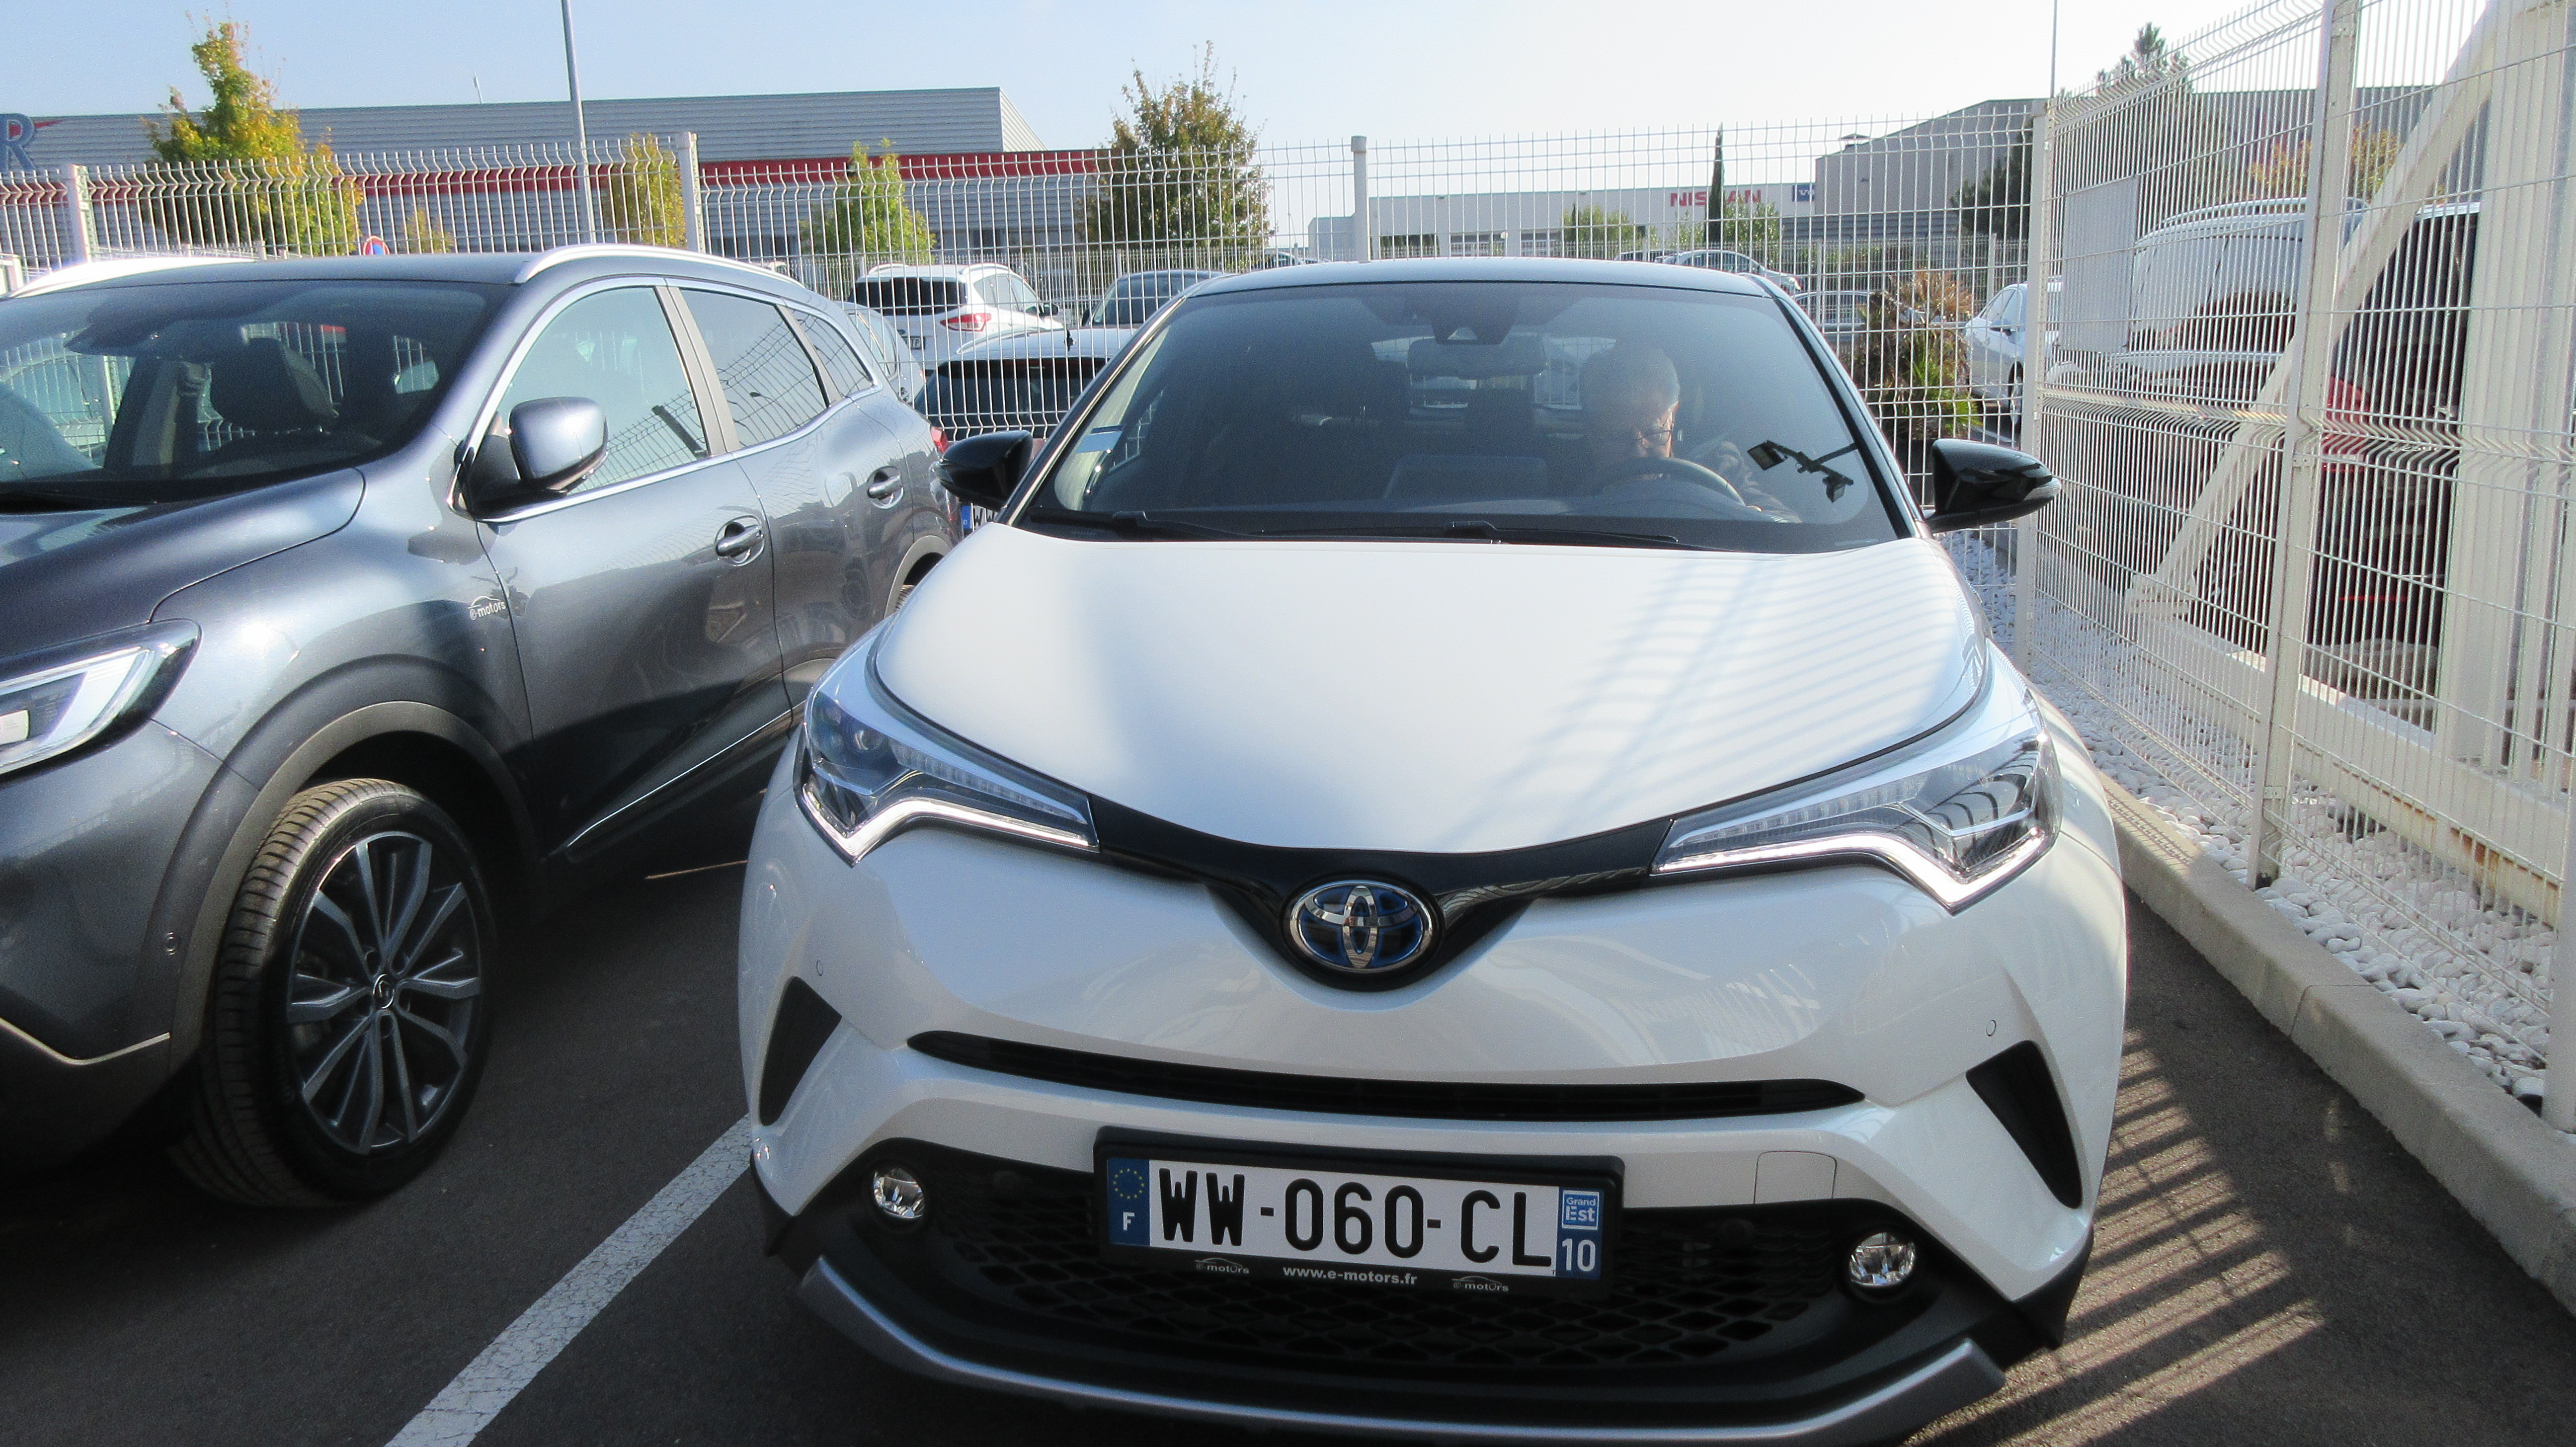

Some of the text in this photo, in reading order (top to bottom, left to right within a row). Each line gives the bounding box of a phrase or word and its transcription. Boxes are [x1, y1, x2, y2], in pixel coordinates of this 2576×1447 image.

[1670, 190, 1761, 207] NISAN
[1566, 1197, 1596, 1206] Grand
[1123, 1211, 1135, 1231] F
[1159, 1168, 1552, 1268] WW-060-CL
[1565, 1206, 1595, 1222] Est
[1562, 1238, 1596, 1272] 10
[1283, 1267, 1417, 1285] www.e-motors.fr
